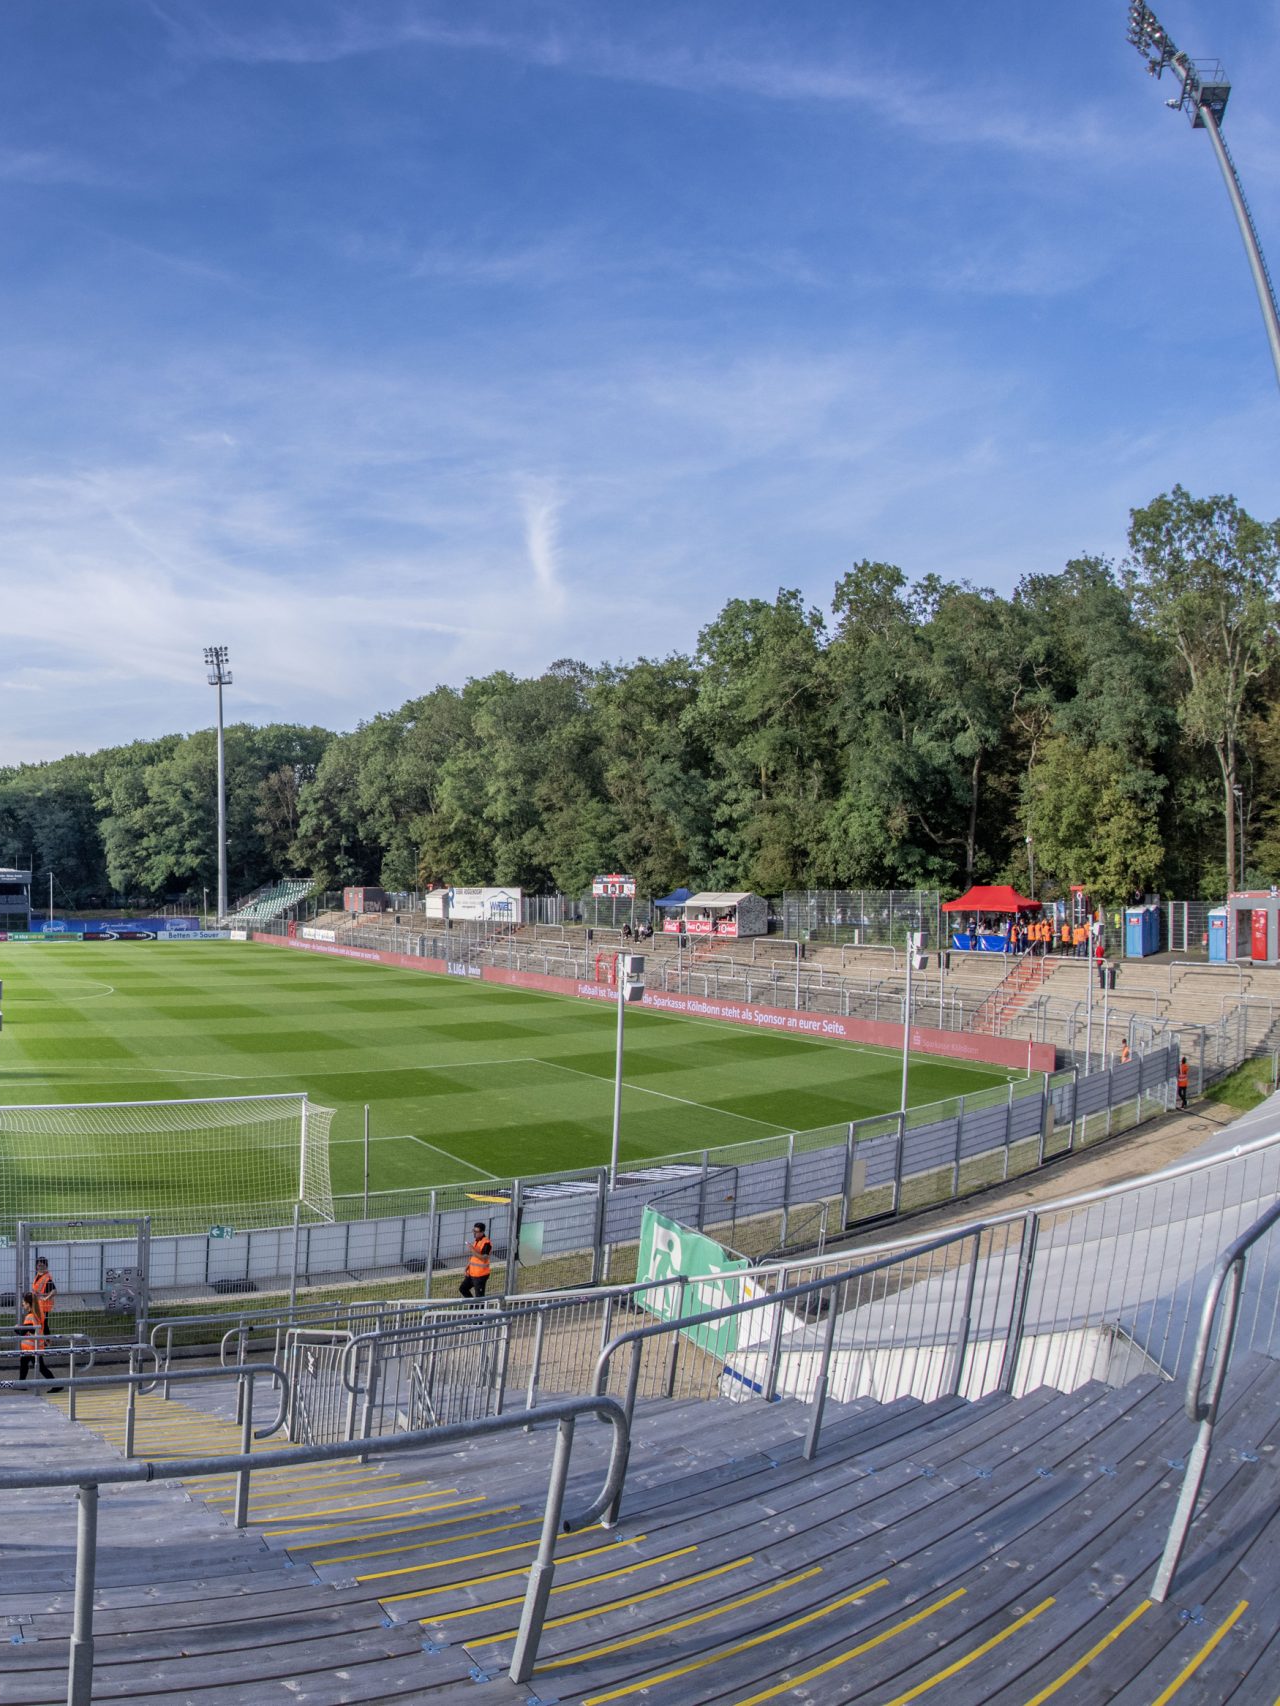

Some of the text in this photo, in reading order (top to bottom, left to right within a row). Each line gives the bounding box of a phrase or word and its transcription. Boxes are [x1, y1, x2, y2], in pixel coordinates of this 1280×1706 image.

[453, 963, 466, 976] LIGA
[578, 984, 599, 996] Fußball
[598, 986, 607, 997] ist
[642, 994, 653, 1005] die
[653, 994, 686, 1010] Sparkasse
[686, 1000, 720, 1016] KölnBonn
[721, 1007, 740, 1019] steht
[741, 1008, 753, 1021] als
[754, 1010, 786, 1025] Sponsor
[787, 1016, 798, 1027] an
[799, 1019, 822, 1031] eurer
[822, 1020, 847, 1036] Seite.
